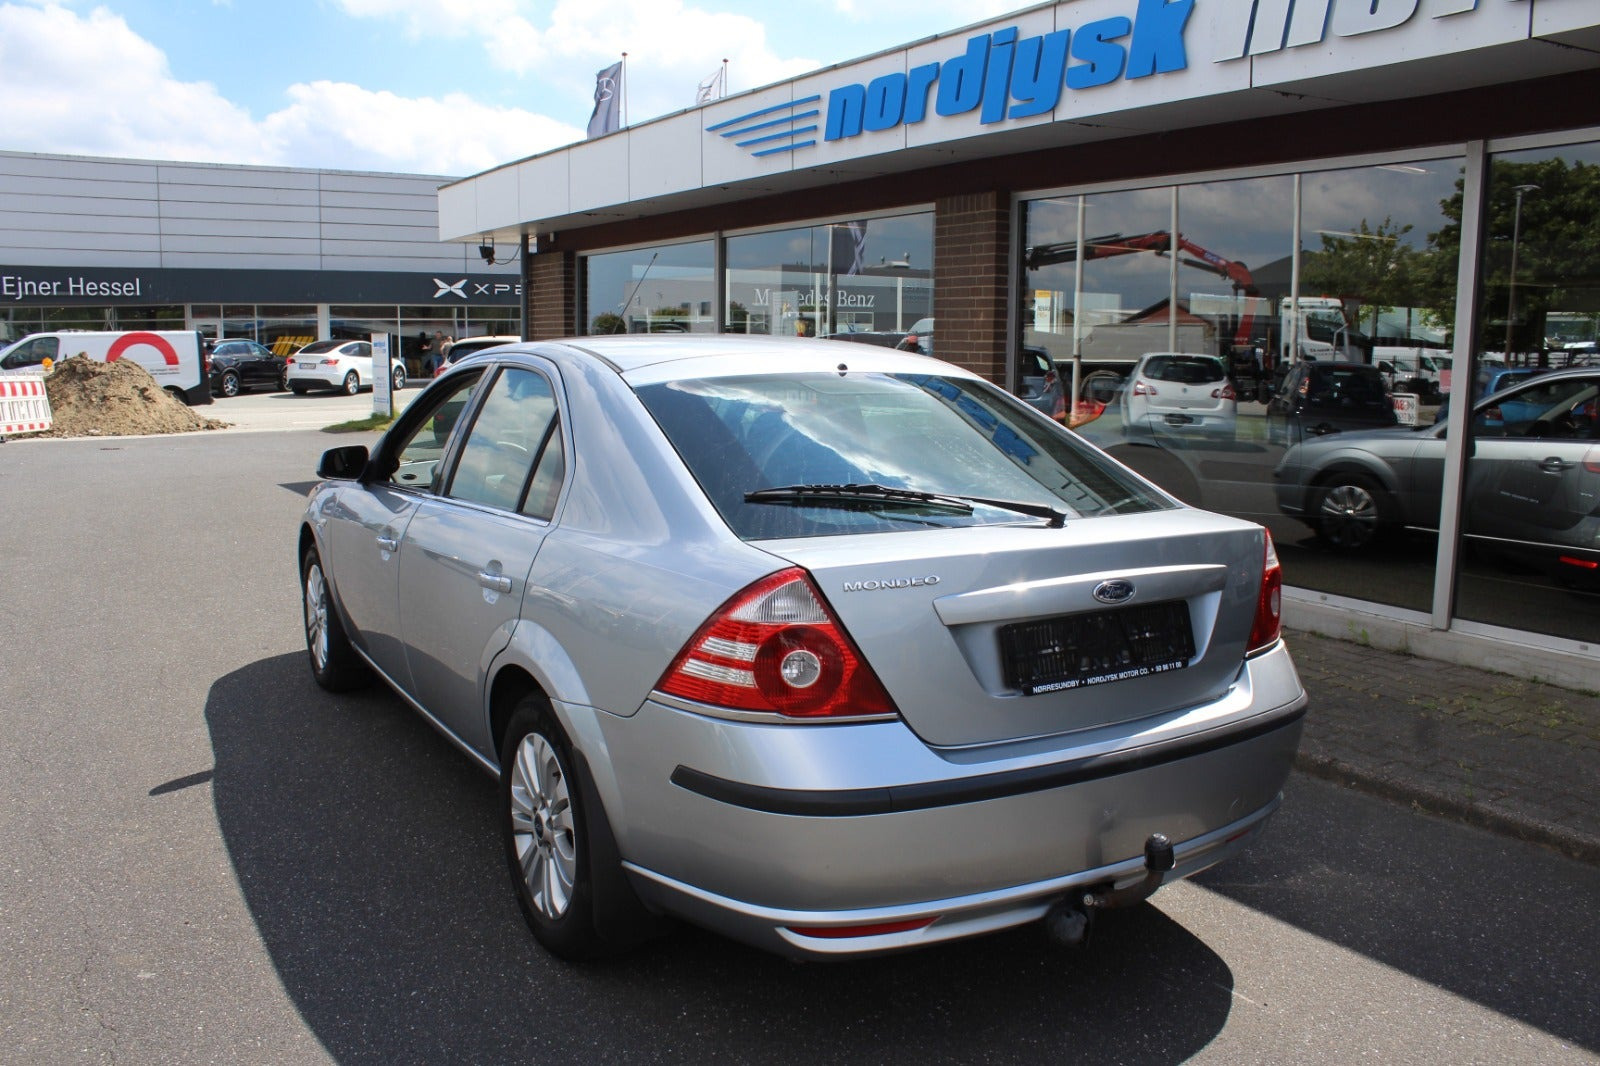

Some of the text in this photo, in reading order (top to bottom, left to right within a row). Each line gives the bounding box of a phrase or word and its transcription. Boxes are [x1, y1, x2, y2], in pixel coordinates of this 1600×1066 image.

[824, 0, 1195, 141] nordjysk
[2, 276, 140, 300] Ejner Hessel
[837, 290, 875, 308] Benz
[843, 575, 940, 592] MONDEO
[1087, 674, 1118, 685] NORDJYSK
[1118, 669, 1139, 679] MOTOR
